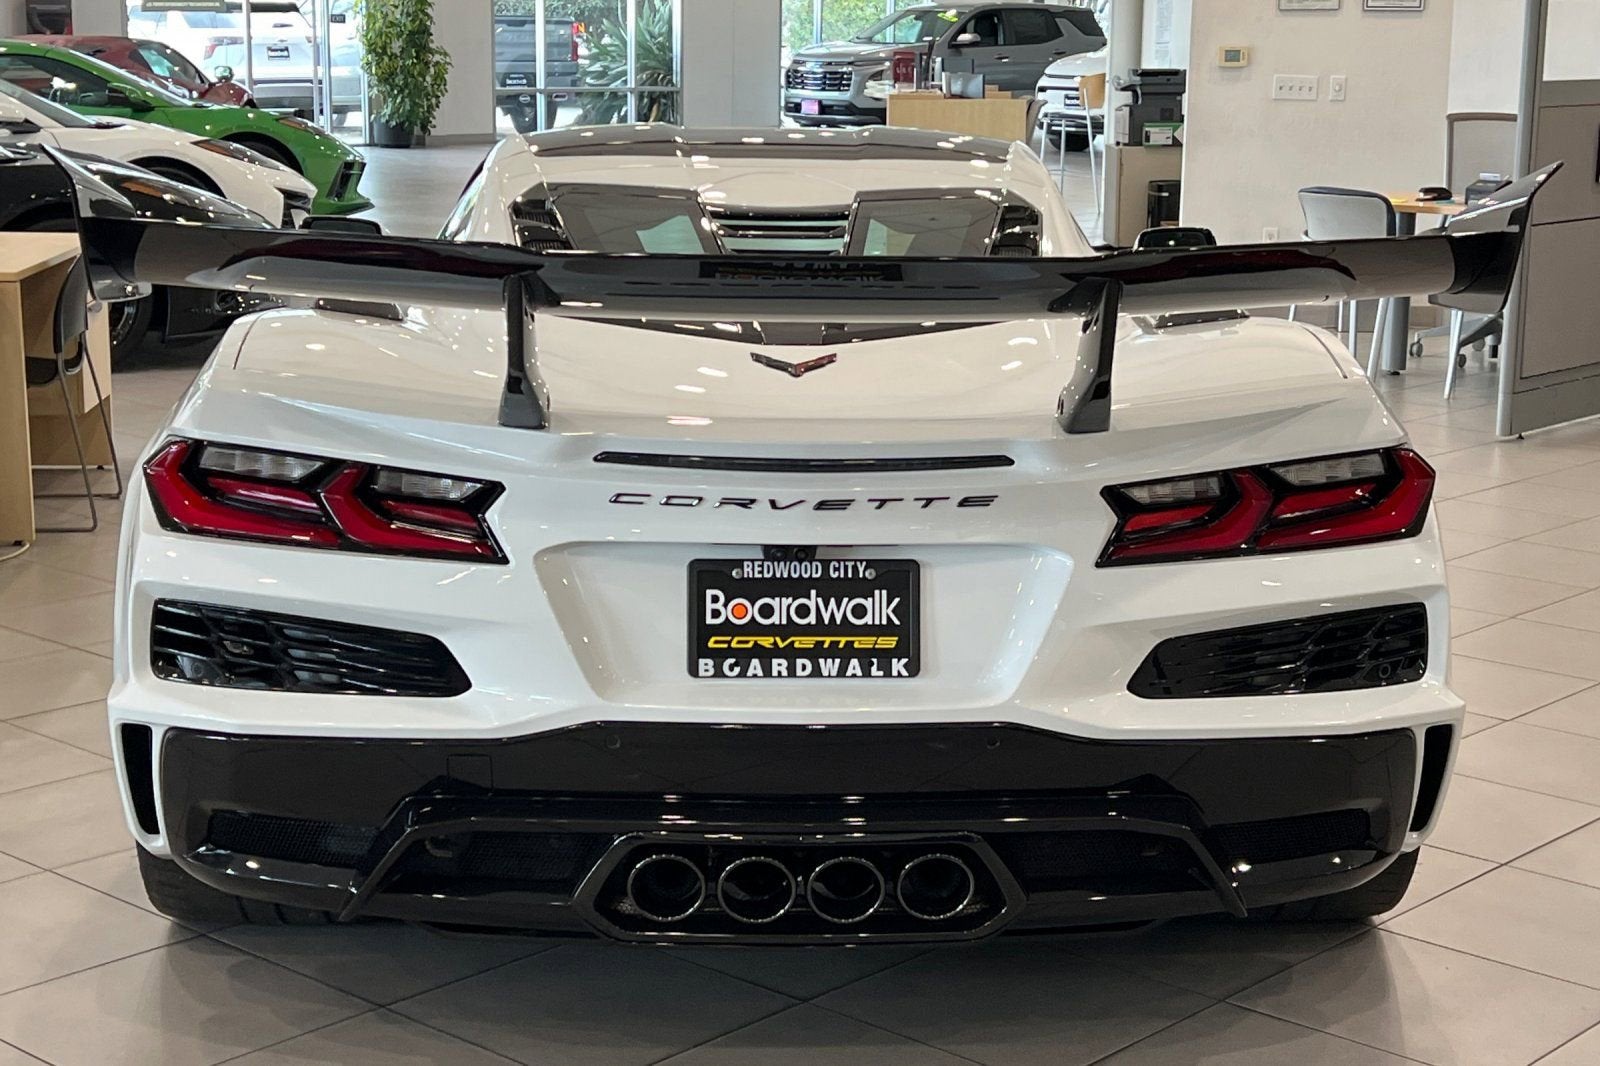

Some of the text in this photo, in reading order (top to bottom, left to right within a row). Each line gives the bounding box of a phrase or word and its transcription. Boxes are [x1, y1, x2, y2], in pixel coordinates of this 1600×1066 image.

[608, 492, 999, 511] CORVETTE
[743, 561, 867, 579] REDWOOD CITY
[705, 588, 901, 625] Boardwalk
[707, 635, 900, 649] CORVETTES
[698, 657, 909, 677] BOARDWALK
